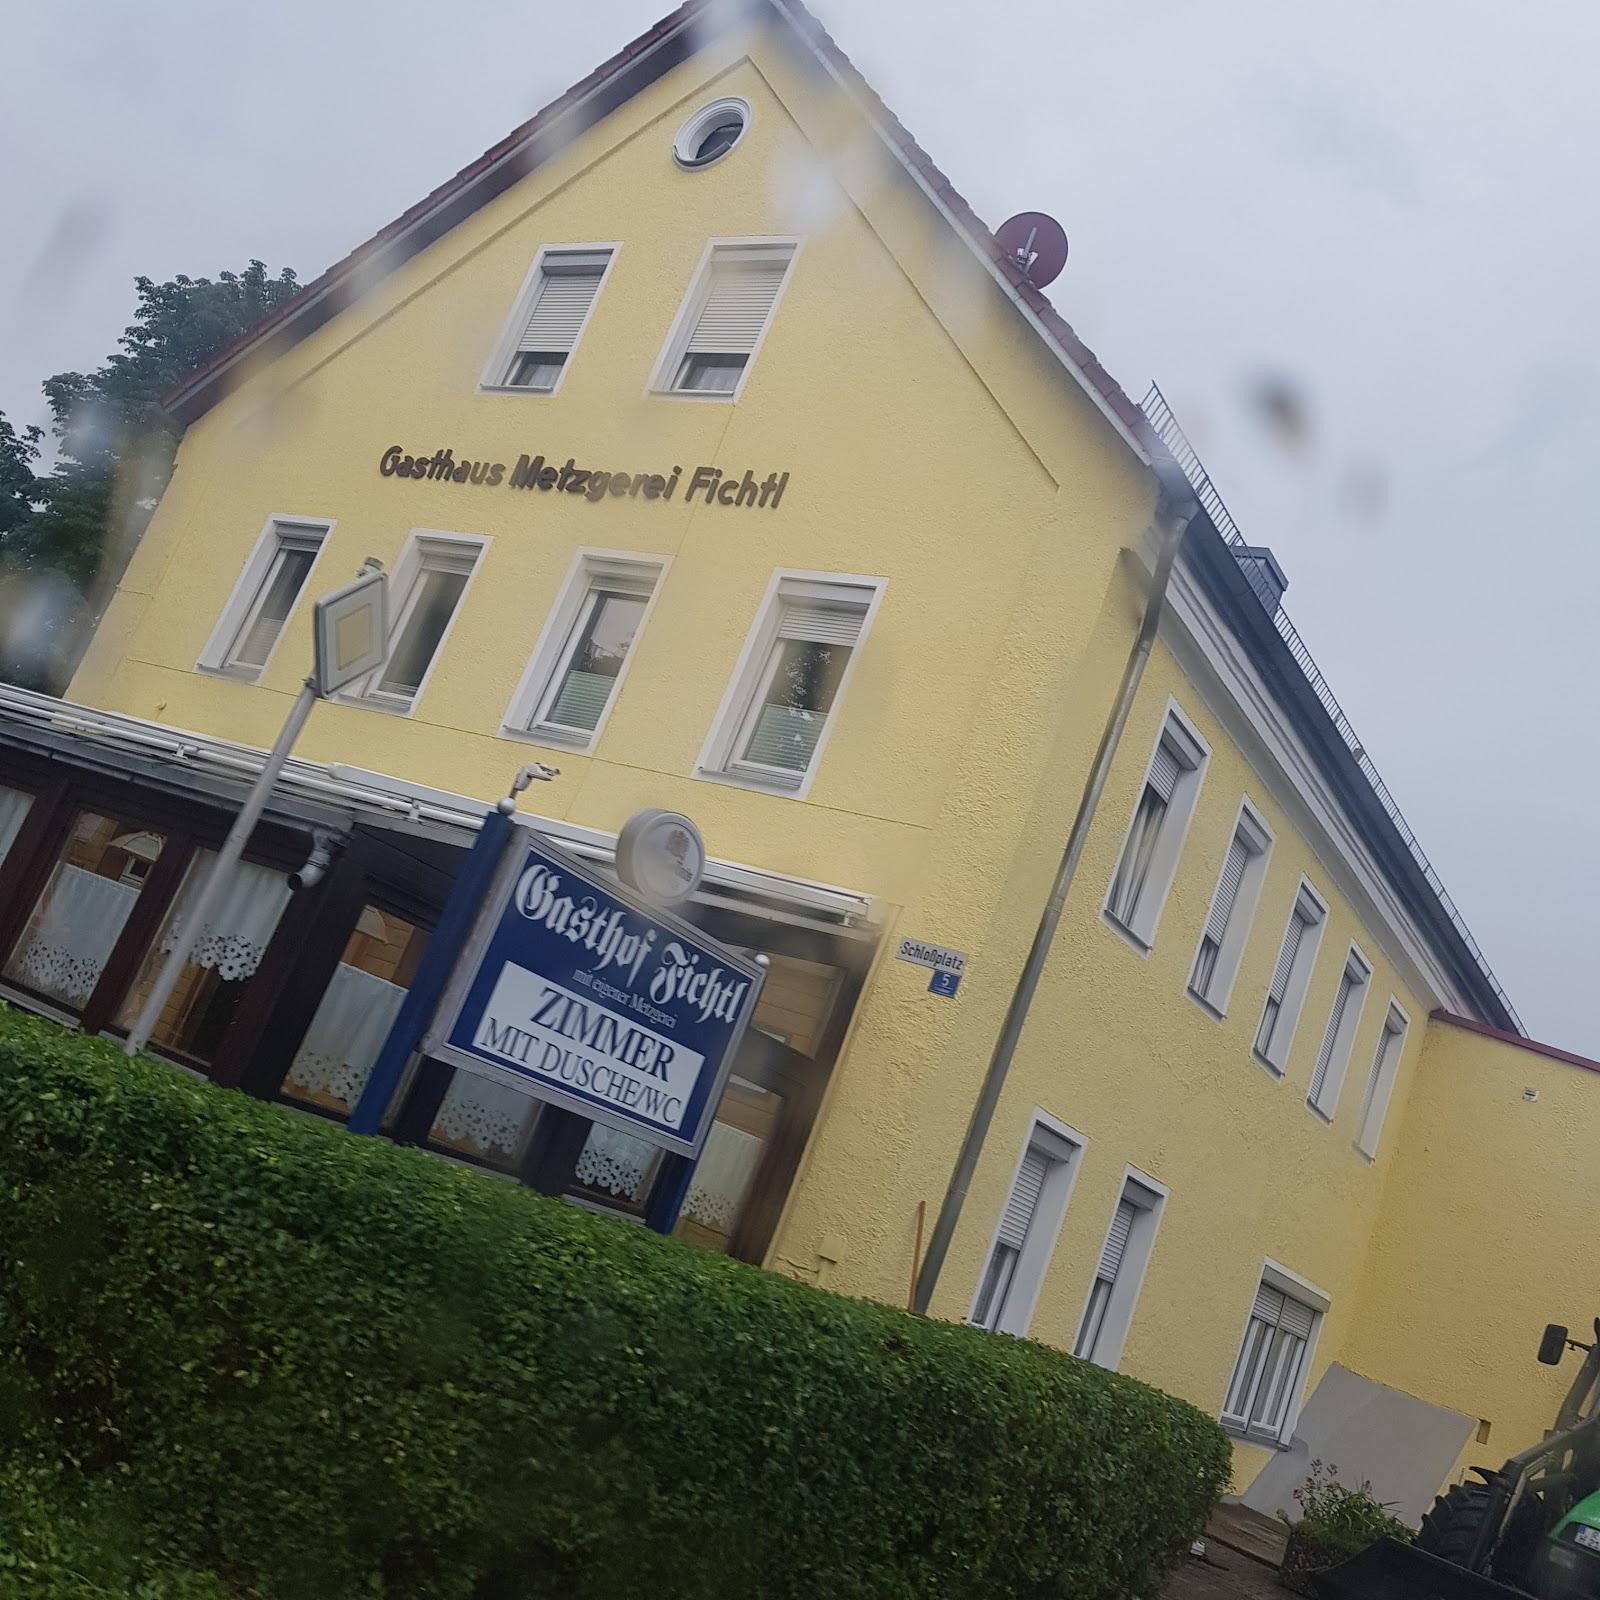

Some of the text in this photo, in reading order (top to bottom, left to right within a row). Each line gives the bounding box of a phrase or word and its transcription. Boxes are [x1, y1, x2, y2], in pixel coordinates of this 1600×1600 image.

[379, 445, 790, 509] Gasthaus Metzgerei Fichtl
[515, 863, 750, 1024] Gasthof Fichtl
[901, 941, 964, 970] Schloßplatz
[941, 974, 952, 987] 5
[480, 1016, 682, 1125] MIT DUSCHE/WC
[530, 987, 676, 1082] ZIMMER
